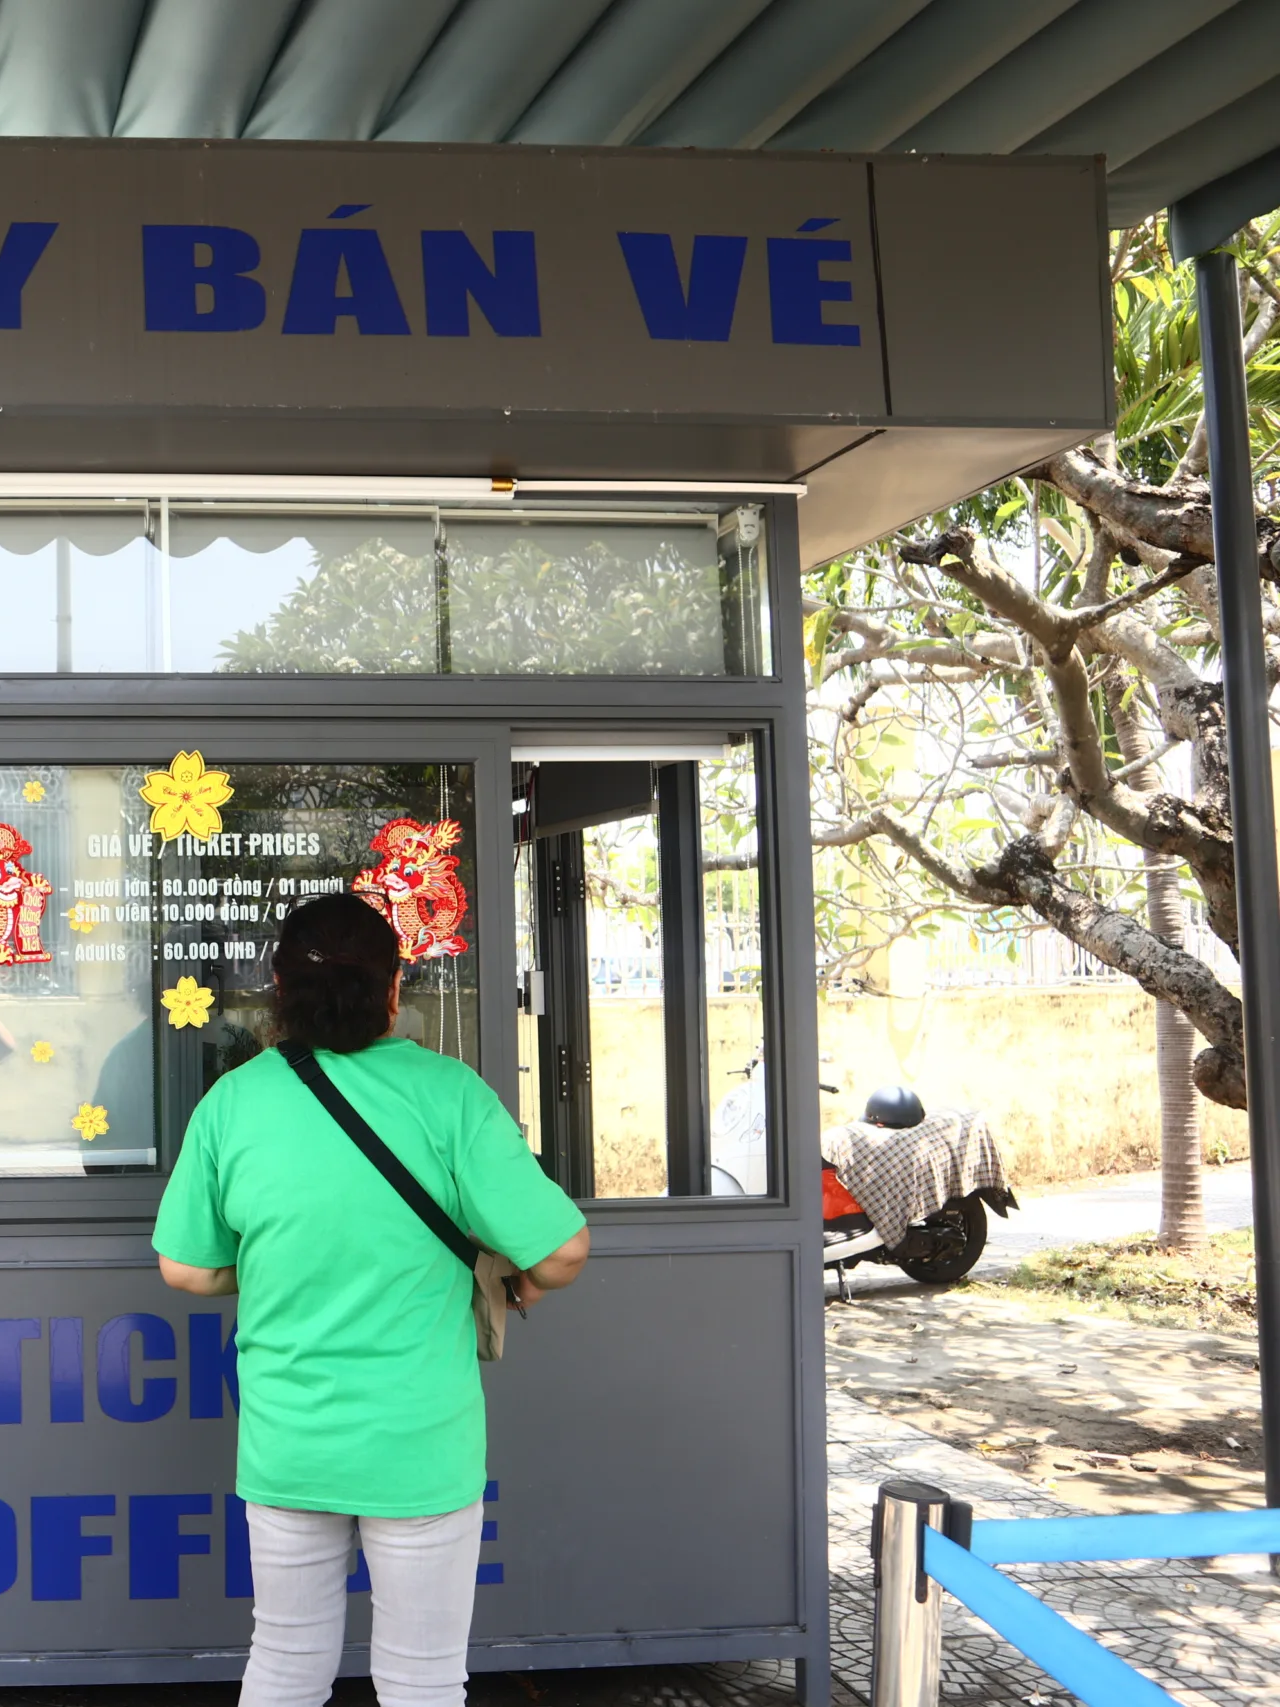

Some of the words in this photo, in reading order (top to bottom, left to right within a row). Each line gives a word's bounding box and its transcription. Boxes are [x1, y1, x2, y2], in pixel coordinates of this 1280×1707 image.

[142, 204, 542, 337] BÁN
[617, 218, 861, 347] VÉ
[88, 826, 122, 857] GIÁ
[176, 833, 242, 857] TICKET
[249, 833, 320, 856] PRICES
[74, 877, 119, 898] Người
[163, 878, 218, 897] 60.000
[223, 873, 261, 899] đồng
[279, 878, 295, 896] 01
[74, 903, 109, 922] Sinh
[163, 903, 214, 922] 10.000
[220, 898, 258, 922] đồng
[75, 943, 126, 962] Adults
[163, 943, 219, 961] 60.000
[224, 942, 256, 959] VNĐ
